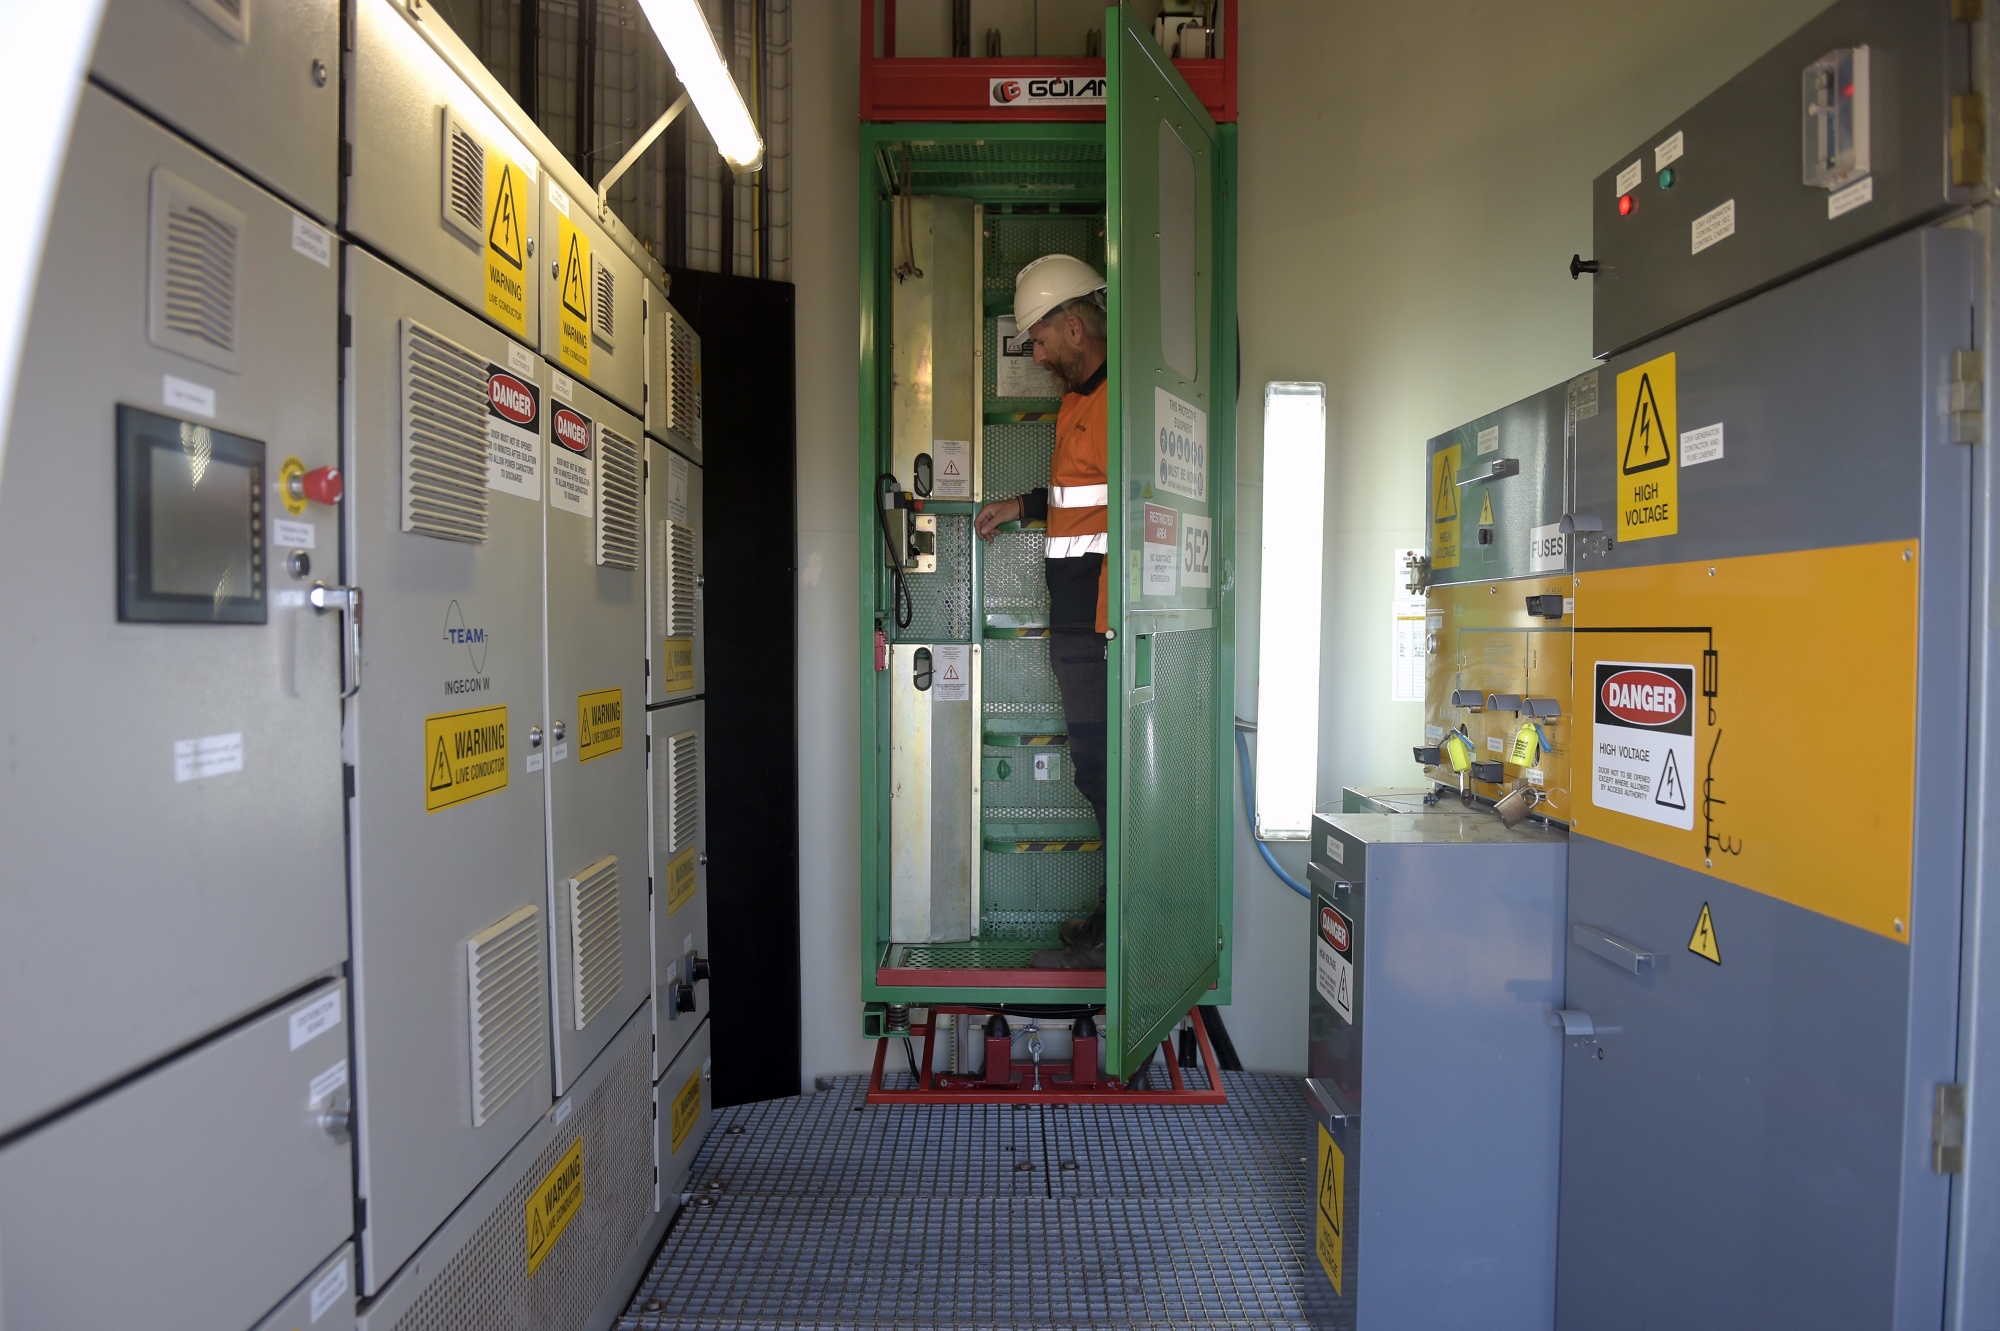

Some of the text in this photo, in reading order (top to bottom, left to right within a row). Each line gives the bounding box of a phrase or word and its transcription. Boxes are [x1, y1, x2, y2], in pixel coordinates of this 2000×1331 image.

[490, 263, 522, 302] WARNING
[489, 292, 522, 321] LIVE CONDUCTOR
[563, 319, 588, 350] WARNING
[570, 349, 588, 368] CONDUCTOR
[493, 380, 531, 417] DANGER
[1169, 399, 1197, 423] THIS PROTECTIVE
[557, 415, 586, 446] DANGER
[1174, 417, 1193, 434] EQUIPMENT
[1695, 428, 1720, 440] GENERATOR
[491, 429, 500, 440] DOOR
[500, 432, 509, 443] MUST
[521, 440, 532, 452] OPENED
[1684, 438, 1719, 453] CONTACTOR AND
[498, 444, 511, 456] MINUTES
[512, 449, 521, 459] AFTER
[522, 453, 536, 465] ISOLATION
[1687, 449, 1717, 462] FUSE CABINET
[494, 455, 504, 466] ALLOW
[505, 458, 515, 469] POWER
[516, 462, 534, 475] CAPACITORS
[1168, 463, 1180, 479] MUST
[1181, 467, 1186, 481] BE
[506, 470, 522, 483] DISCHARGE
[1634, 482, 1658, 503] HIGH
[1150, 511, 1173, 527] RESTRICTED
[1625, 503, 1669, 527] VOLTAGE
[1156, 527, 1167, 540] AREA
[1440, 530, 1451, 543] HIGH
[1185, 526, 1209, 574] 5E2
[1435, 545, 1456, 560] VOLTAGE
[1531, 537, 1563, 558] FUSES
[1607, 538, 1613, 551] B
[1155, 564, 1167, 573] WITHOUT
[1156, 554, 1172, 564] ADMITTANCE
[448, 628, 484, 645] TEAM
[444, 677, 490, 695] INGECON W
[1609, 682, 1676, 714] DANGER
[591, 701, 620, 726] WARNING
[454, 723, 504, 760] WARNING
[600, 726, 620, 743] CONDUCTOR
[1599, 742, 1650, 762] HIGH VOLTAGE
[455, 766, 469, 785] LIVE
[471, 757, 504, 781] CONDUCTOR
[1598, 766, 1651, 784] DOOR NOT TO BE OPENED
[1599, 774, 1650, 792] EXCEPT WHERE ALLOWED
[1601, 783, 1647, 800] BY ACCESS AUTHORITY
[1322, 912, 1347, 947] DANGER
[1326, 955, 1337, 971] VOLTAGE
[296, 1000, 334, 1028] DISTRIBUTION
[1597, 1047, 1603, 1060] C
[544, 1154, 580, 1217] WARNING
[545, 1181, 580, 1237] LIVE CONDUCTOR
[1323, 1225, 1334, 1254] HIGH
[1320, 1236, 1338, 1280] VOLTAGE
